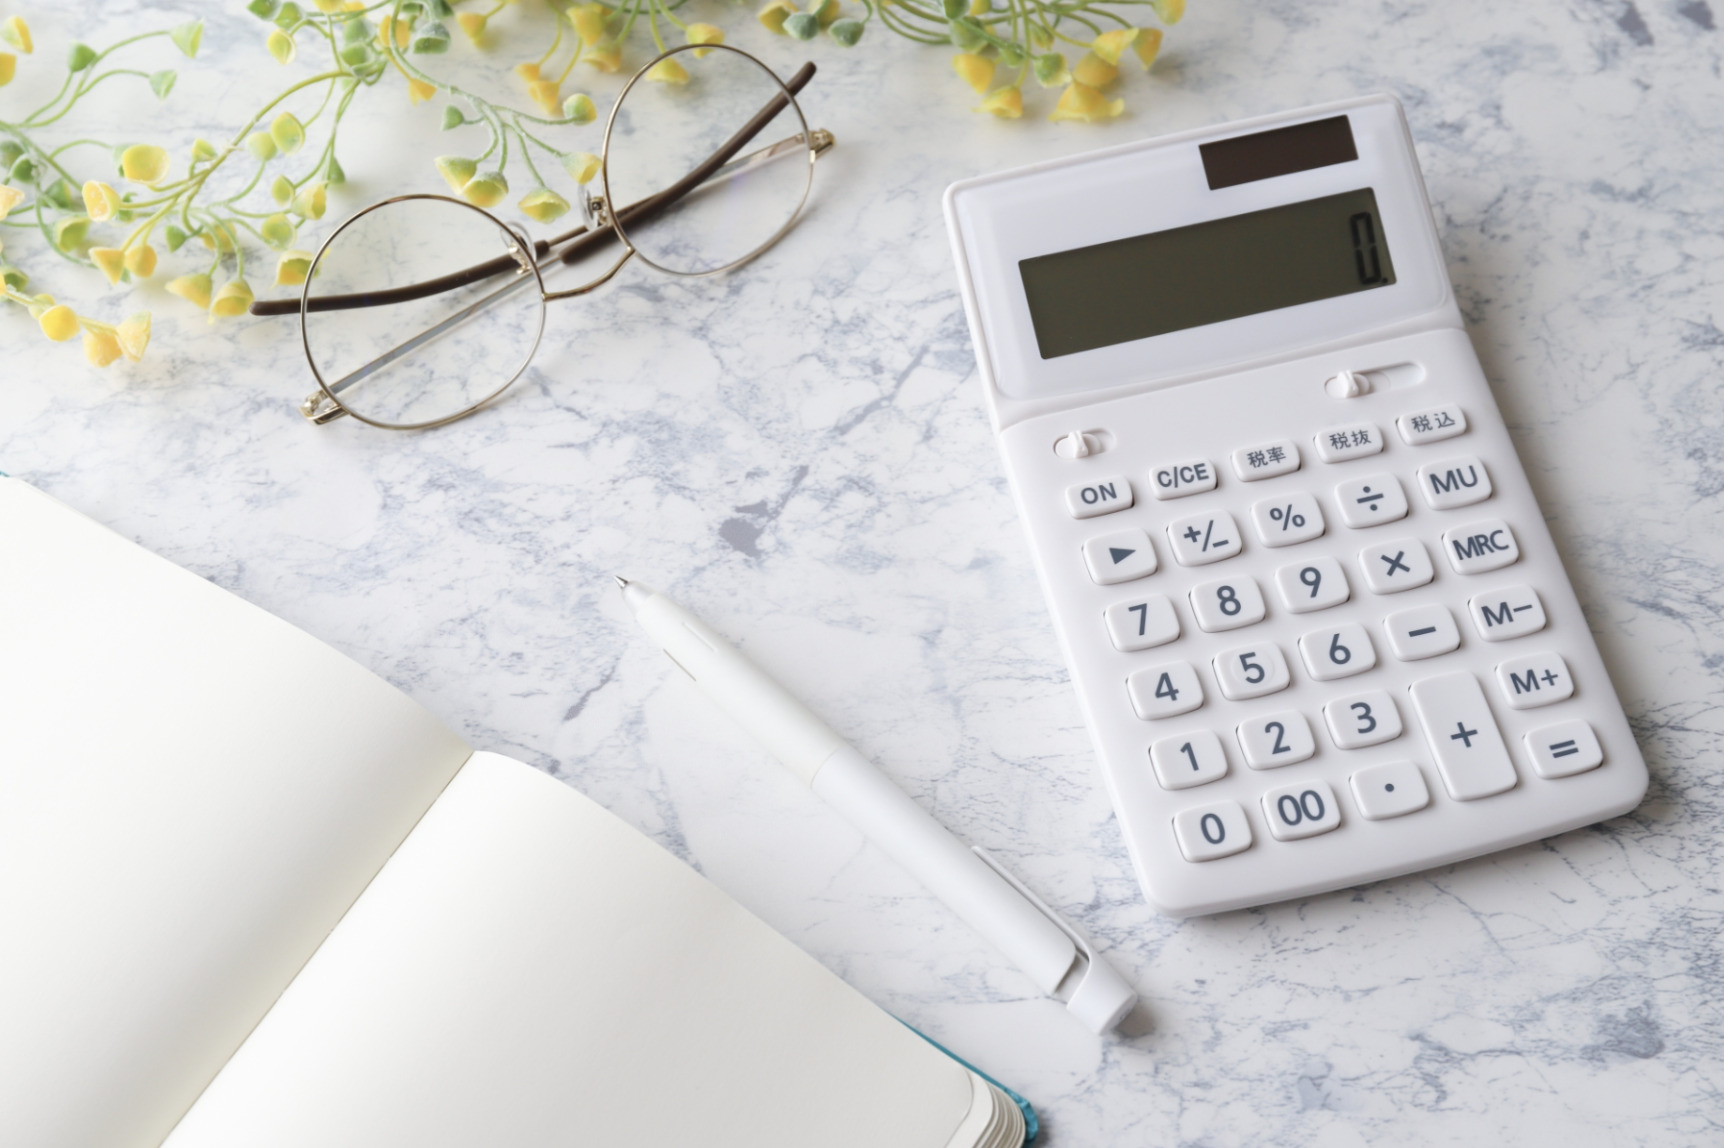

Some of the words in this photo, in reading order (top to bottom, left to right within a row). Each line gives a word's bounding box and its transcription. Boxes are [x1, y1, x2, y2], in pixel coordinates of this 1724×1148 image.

[1410, 410, 1457, 434] 税込
[1328, 428, 1373, 451] 税抜
[1245, 445, 1288, 469] 税率
[1156, 462, 1210, 489] C/CE
[1428, 464, 1480, 495] MU
[1079, 482, 1118, 507] ON
[1269, 503, 1306, 532] %
[1452, 528, 1511, 563] MRC
[1299, 566, 1322, 599] 9
[1216, 585, 1242, 617] 8
[1127, 602, 1150, 637] 7
[1328, 632, 1352, 665] 6
[1238, 651, 1266, 684] 5
[1509, 668, 1559, 695] M+
[1154, 671, 1180, 702] 4
[1350, 701, 1377, 735] 3
[1264, 721, 1292, 755] 2
[1179, 741, 1200, 772] 1
[1277, 789, 1326, 828] 00
[1199, 812, 1226, 845] 0
